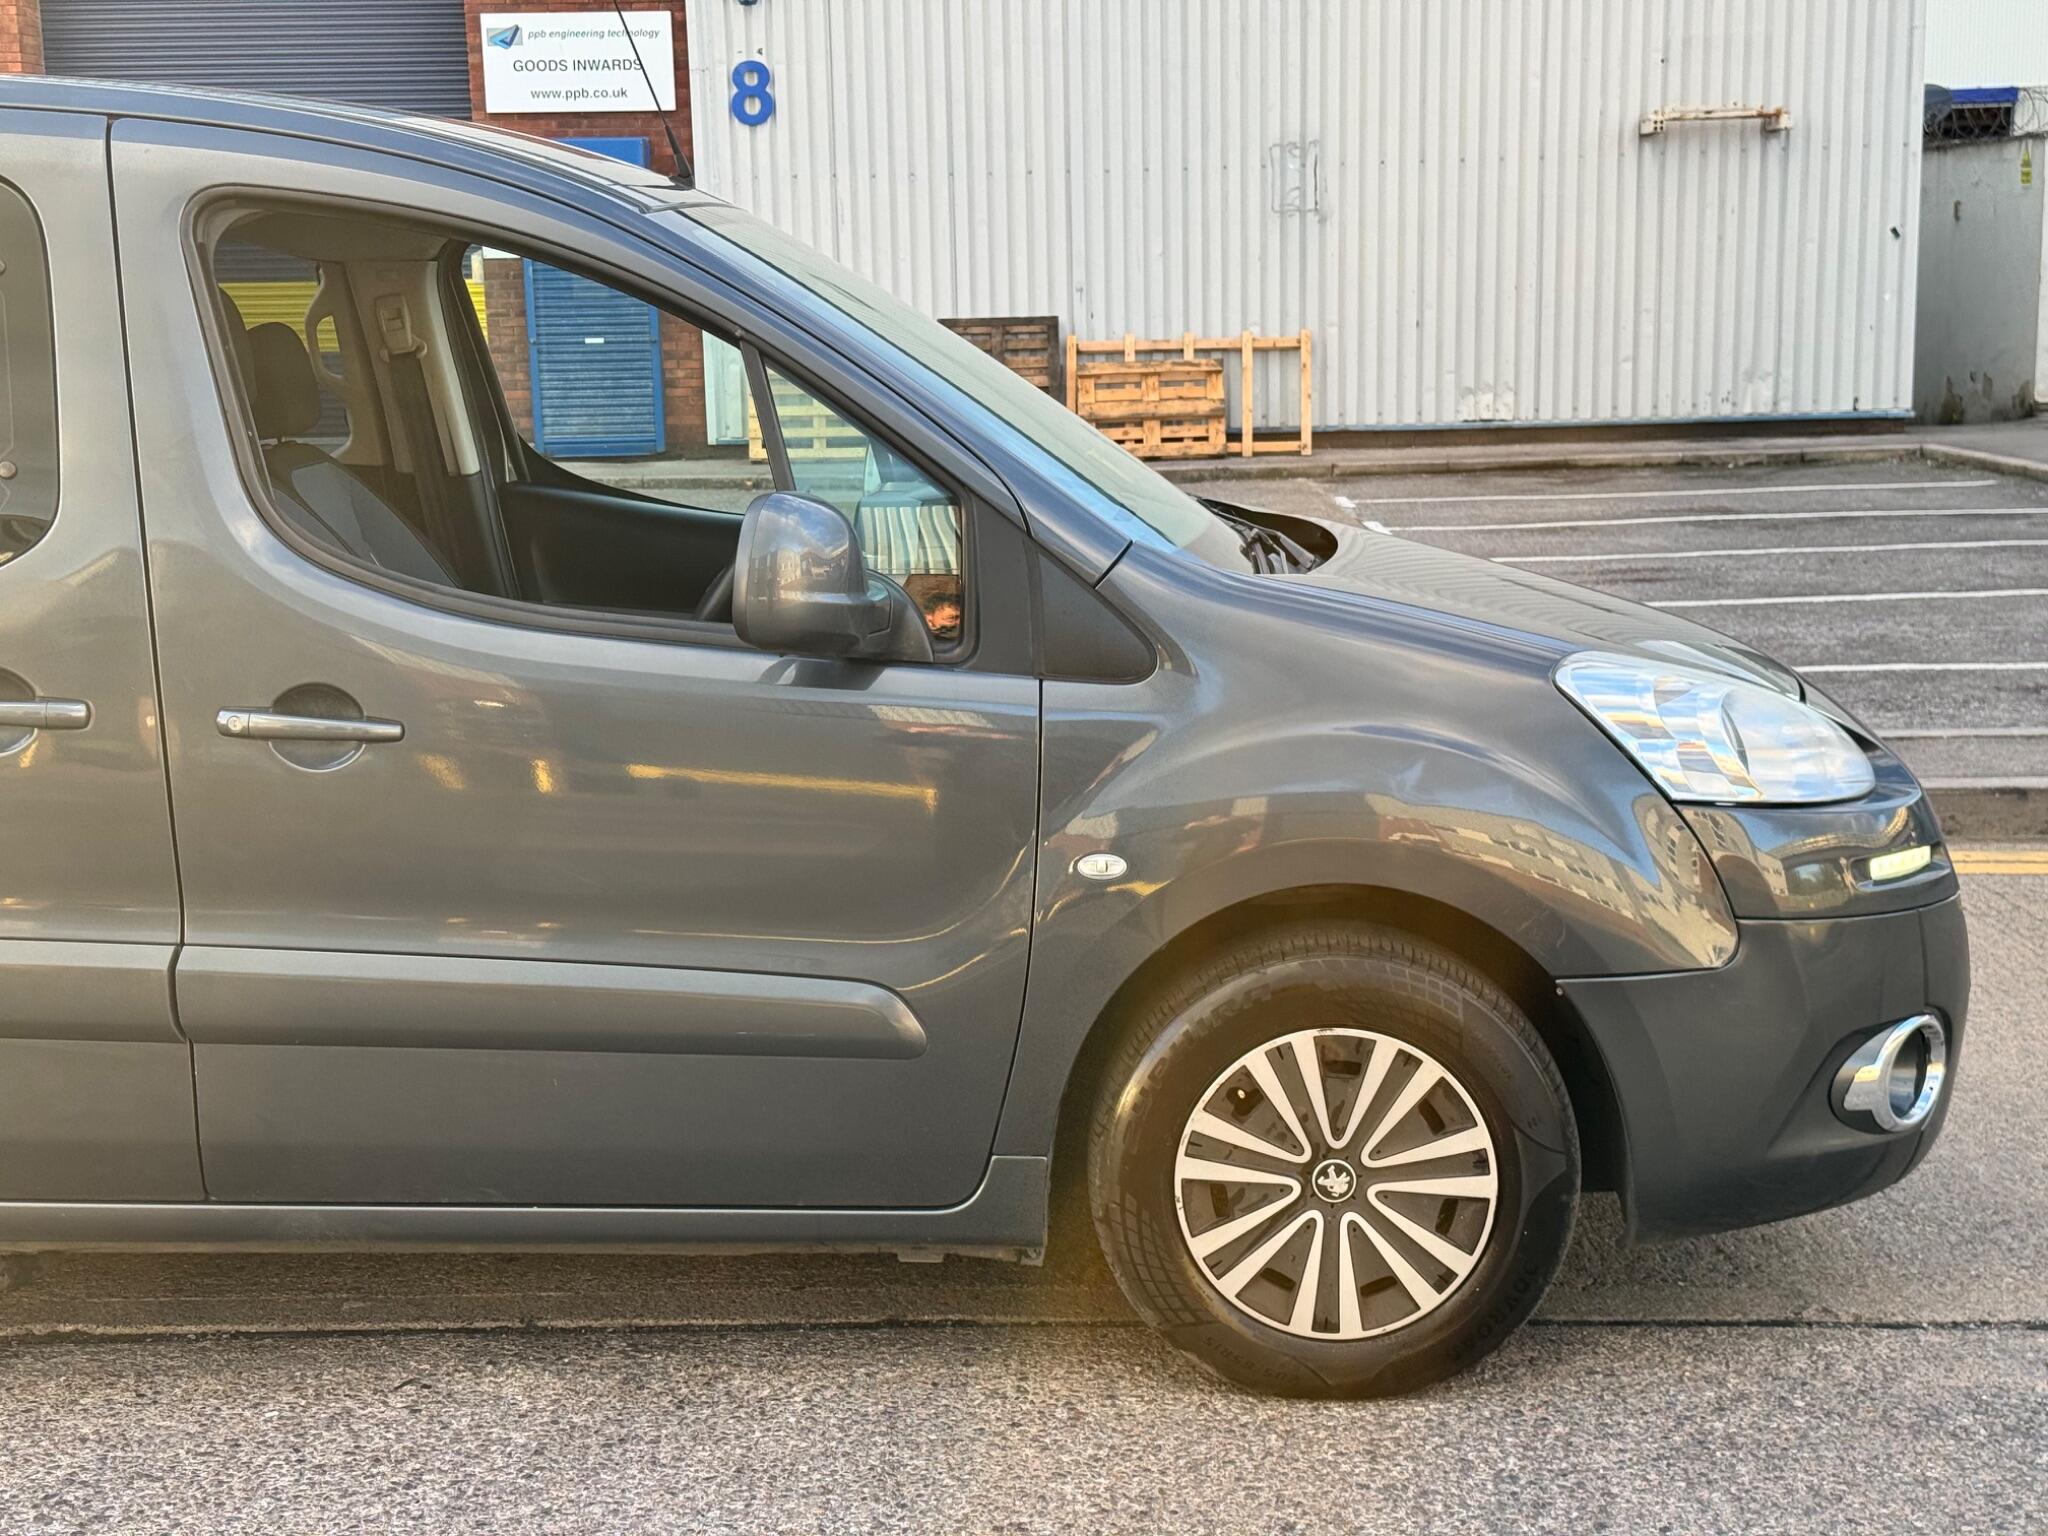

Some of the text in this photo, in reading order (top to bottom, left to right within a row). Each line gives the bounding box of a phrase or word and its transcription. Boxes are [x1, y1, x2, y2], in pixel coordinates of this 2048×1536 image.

[528, 30, 546, 40] ppb
[549, 29, 604, 40] engineering
[513, 58, 643, 72] GOODS INWARDS
[530, 87, 628, 101] www.ppb.co.uk
[732, 60, 773, 127] 8
